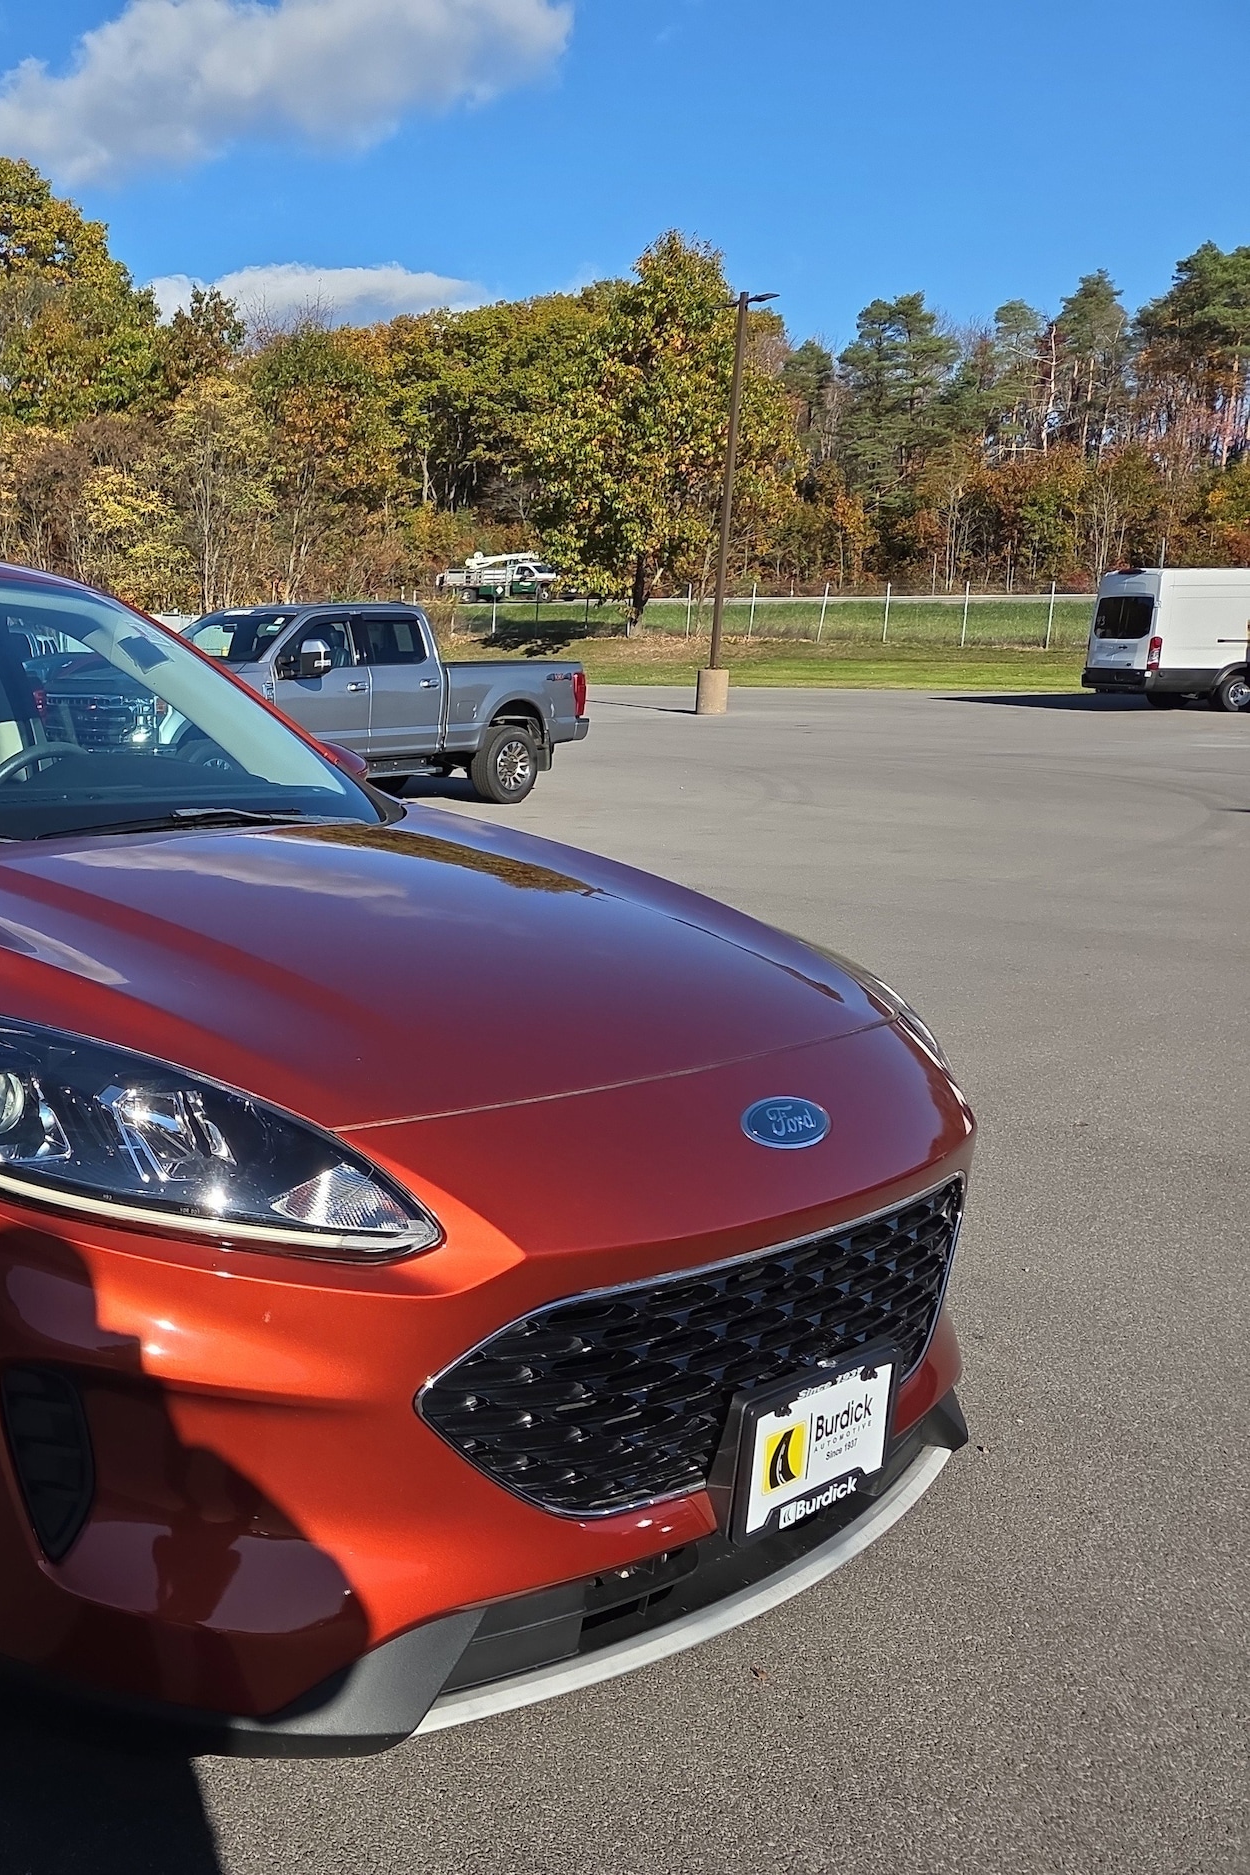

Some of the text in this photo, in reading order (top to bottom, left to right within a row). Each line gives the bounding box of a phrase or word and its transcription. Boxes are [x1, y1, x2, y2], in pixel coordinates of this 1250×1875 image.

[765, 1104, 817, 1137] Ford
[815, 1393, 873, 1442] Burdick
[814, 1419, 872, 1453] AUTOMOTIVE
[825, 1447, 842, 1461] Since
[795, 1475, 858, 1520] Burdick
